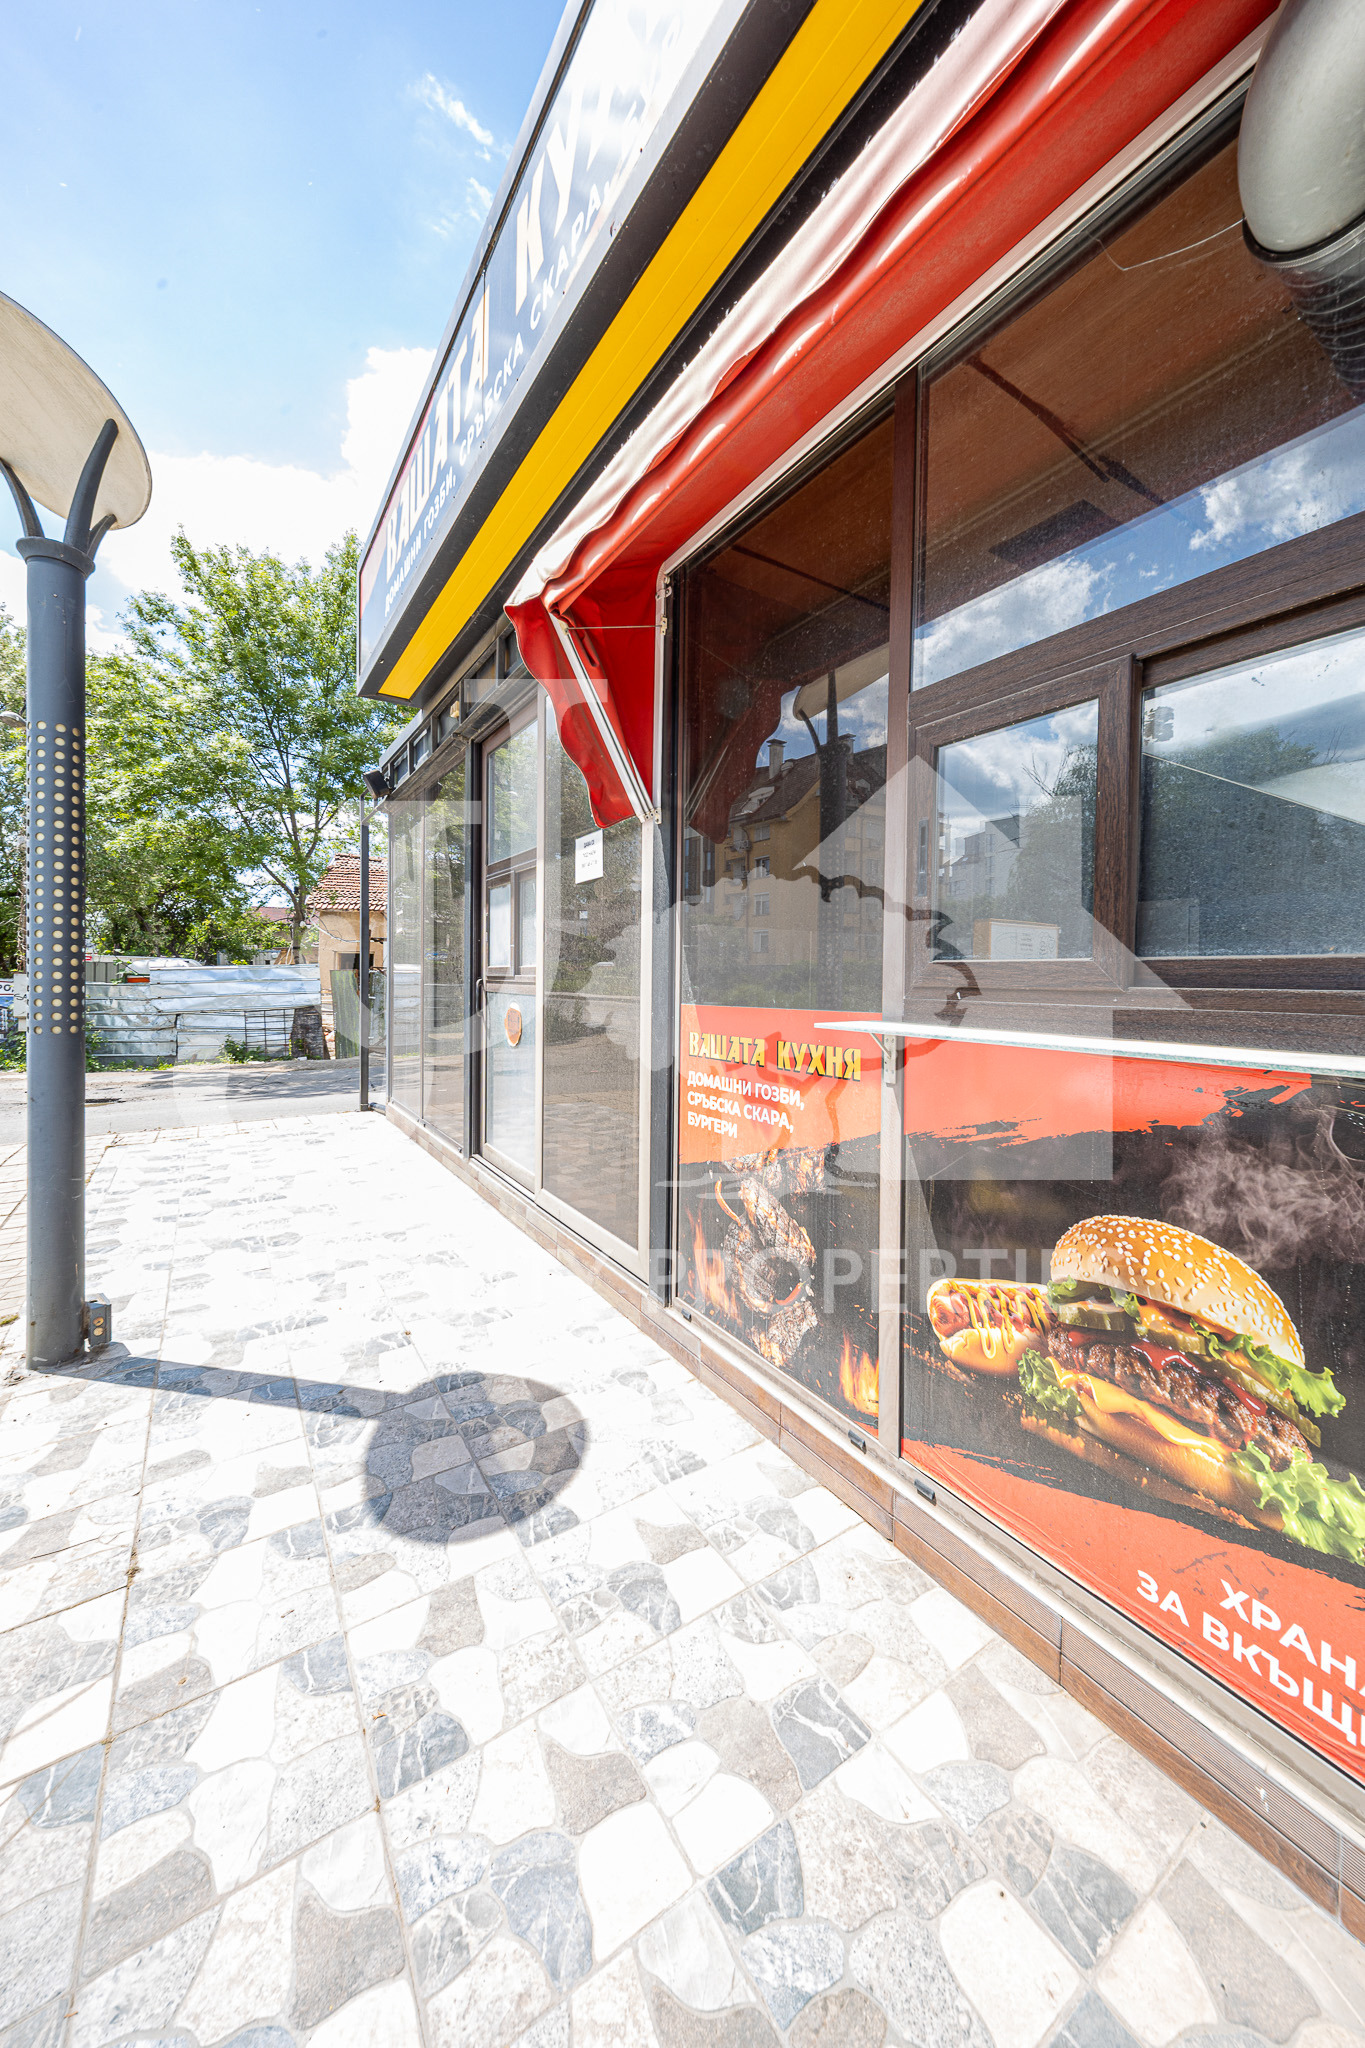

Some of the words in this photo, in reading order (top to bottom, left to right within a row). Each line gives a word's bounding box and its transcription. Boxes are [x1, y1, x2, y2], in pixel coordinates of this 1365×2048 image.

[384, 534, 421, 617] ДОМАШНИ
[423, 466, 457, 541] ГОЗБИ,
[459, 332, 524, 467] СРЪБСКА
[386, 284, 490, 584] ВАШАТА
[687, 1070, 752, 1098] ДОМАШНИ
[755, 1083, 805, 1111] ГОЗБИ,
[688, 1031, 766, 1067] ВАШАТА
[777, 1040, 862, 1082] КУХНЯ
[687, 1091, 742, 1118] СРЪБСКА
[743, 1103, 794, 1133] СКАРА,
[687, 1111, 738, 1138] БУРГЕРИ
[1136, 1569, 1190, 1628] ЗА
[1203, 1611, 1365, 1747] ВКЪЩ
[1219, 1578, 1365, 1697] ХРАН
